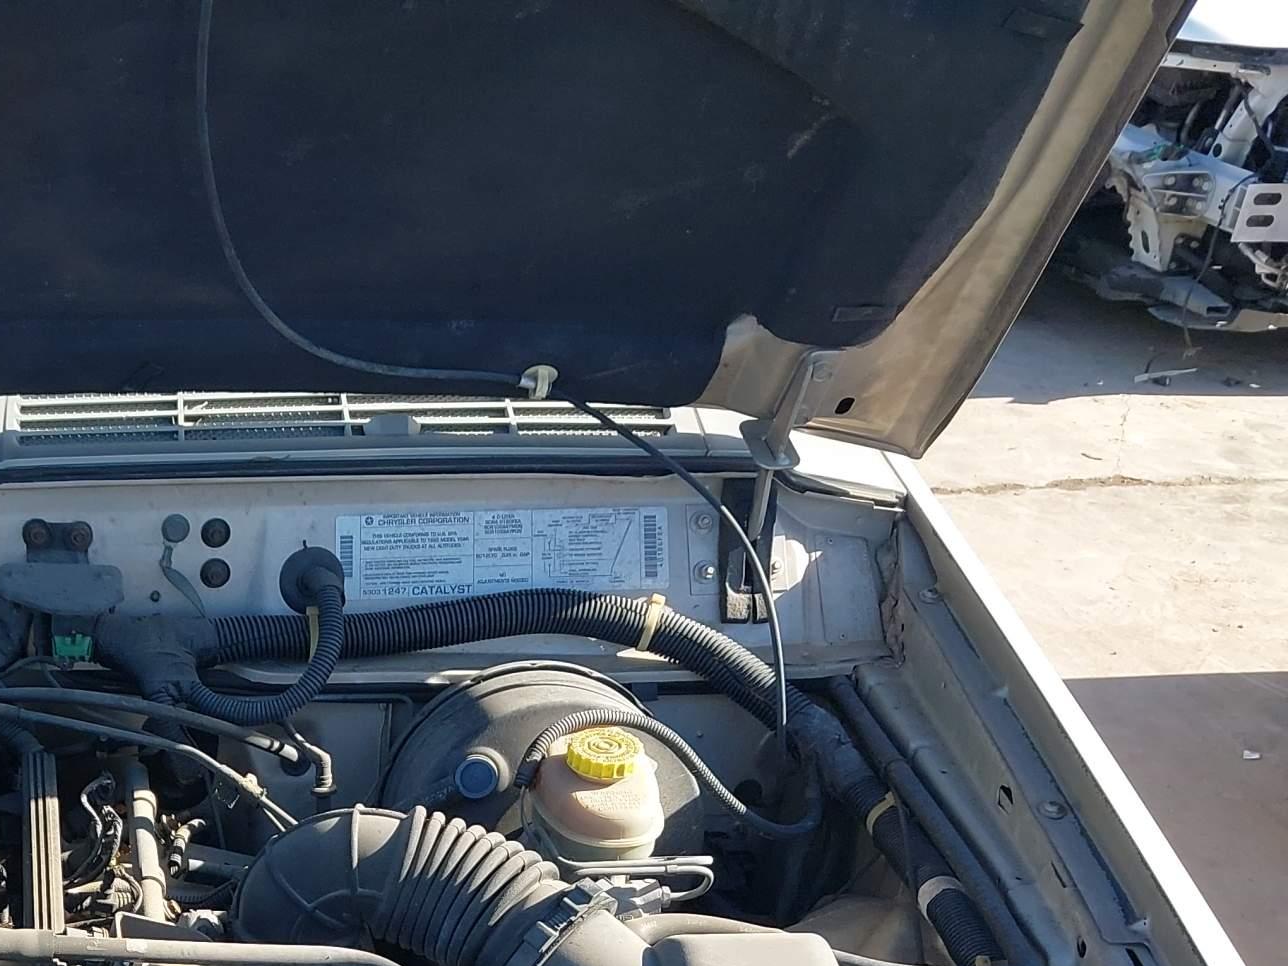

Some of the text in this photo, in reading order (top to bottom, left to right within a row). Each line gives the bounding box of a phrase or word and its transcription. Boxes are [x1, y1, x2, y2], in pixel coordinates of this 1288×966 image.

[378, 516, 470, 526] CHRYSLER CORPORATION
[412, 584, 473, 596] CATALYST
